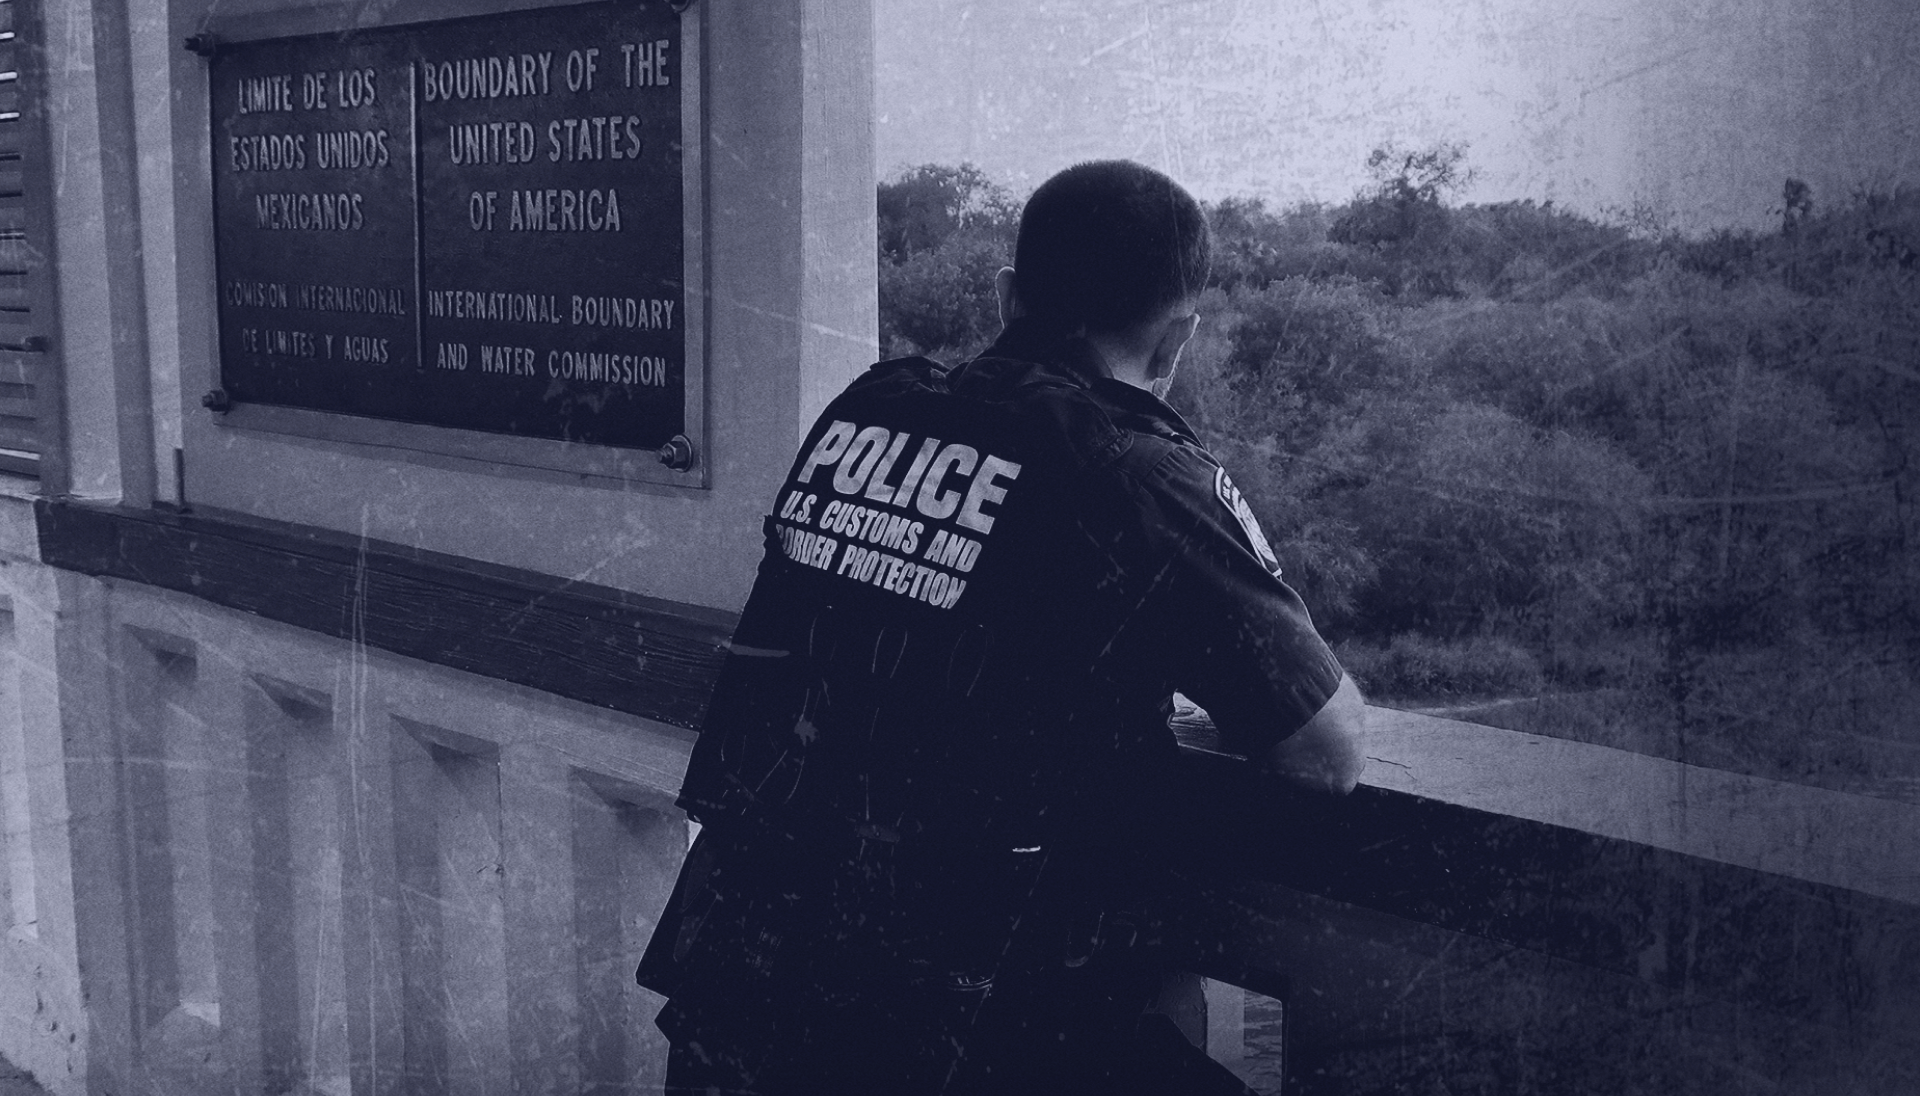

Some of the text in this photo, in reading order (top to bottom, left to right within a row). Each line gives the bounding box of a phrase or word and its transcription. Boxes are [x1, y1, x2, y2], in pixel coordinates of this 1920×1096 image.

[238, 68, 377, 114] LIMITE DE LOS
[424, 40, 671, 101] BOUNDARY OF THE
[230, 130, 390, 171] ESTADOS UNIDOS
[449, 116, 641, 165] UNITED STATES
[255, 193, 365, 230] MEXICANOS
[469, 189, 621, 232] OF AMERICA
[296, 284, 406, 316] INTERNACIONAL
[428, 290, 675, 330] INTERNATIONAL BOUNDARY
[241, 329, 390, 364] DE LIMITES Y AGUAS
[437, 343, 666, 387] AND WATER COMMISSION
[797, 419, 1022, 535] POLICE
[780, 490, 983, 573] U.S. CUSTOMS AND
[836, 544, 967, 609] PROTECTION
